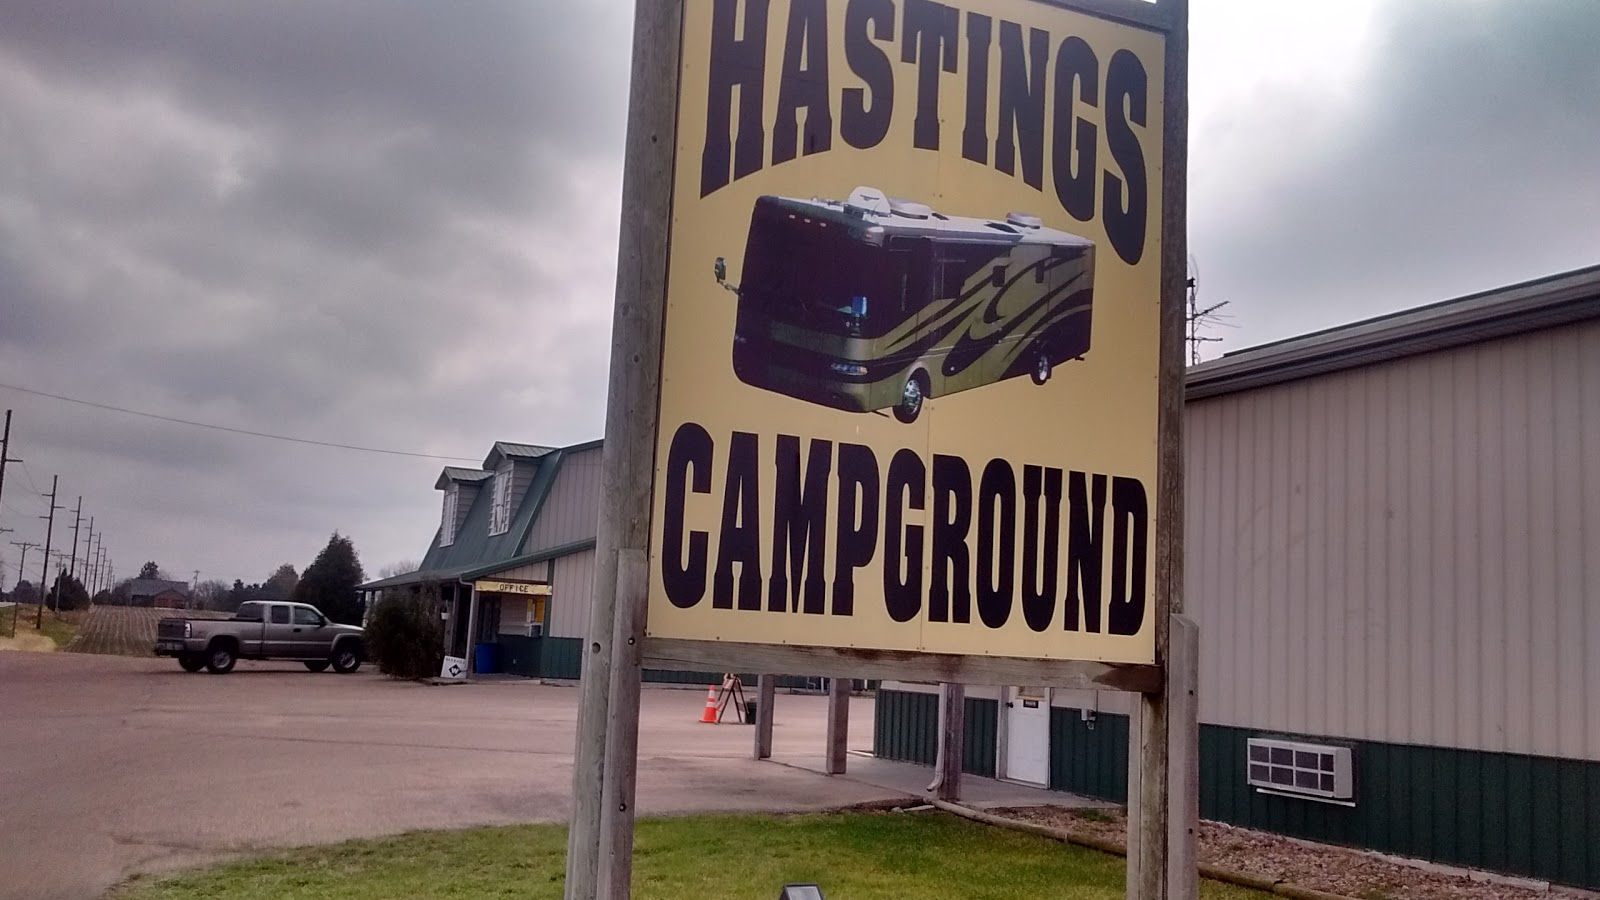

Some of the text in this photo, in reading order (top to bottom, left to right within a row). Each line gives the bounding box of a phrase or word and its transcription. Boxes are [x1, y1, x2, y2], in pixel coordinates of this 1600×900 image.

[700, 0, 1147, 265] HASTINGS
[500, 584, 529, 593] OFFICE
[662, 422, 1148, 636] CAMPGROUND
